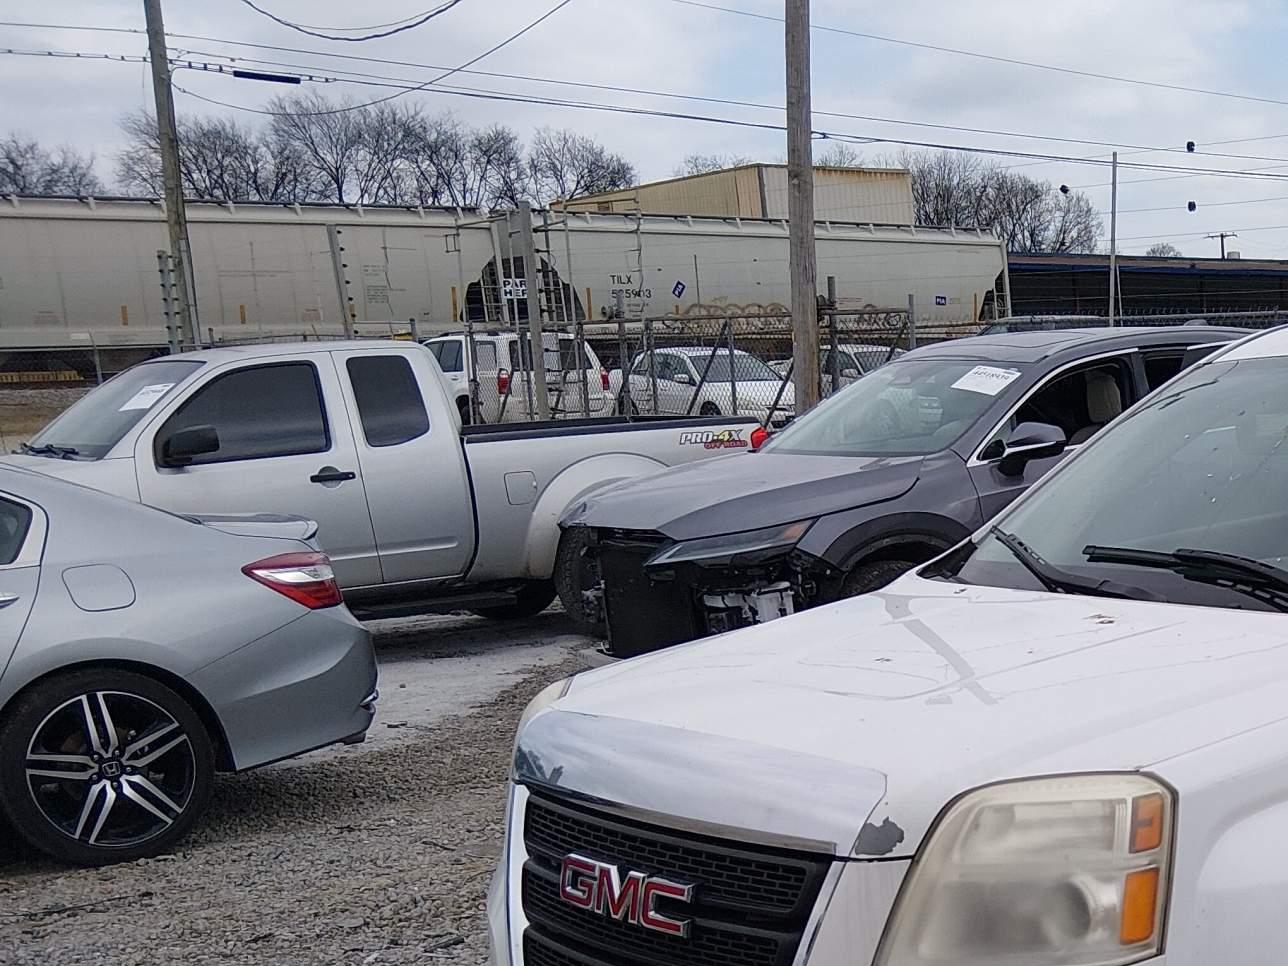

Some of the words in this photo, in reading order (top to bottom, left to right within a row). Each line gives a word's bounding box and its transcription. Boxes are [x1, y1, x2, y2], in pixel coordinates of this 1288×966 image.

[503, 279, 528, 289] PAR
[609, 274, 633, 285] TILX
[503, 289, 528, 298] HER
[679, 429, 743, 445] PRO-4X
[560, 853, 695, 938] GMC
